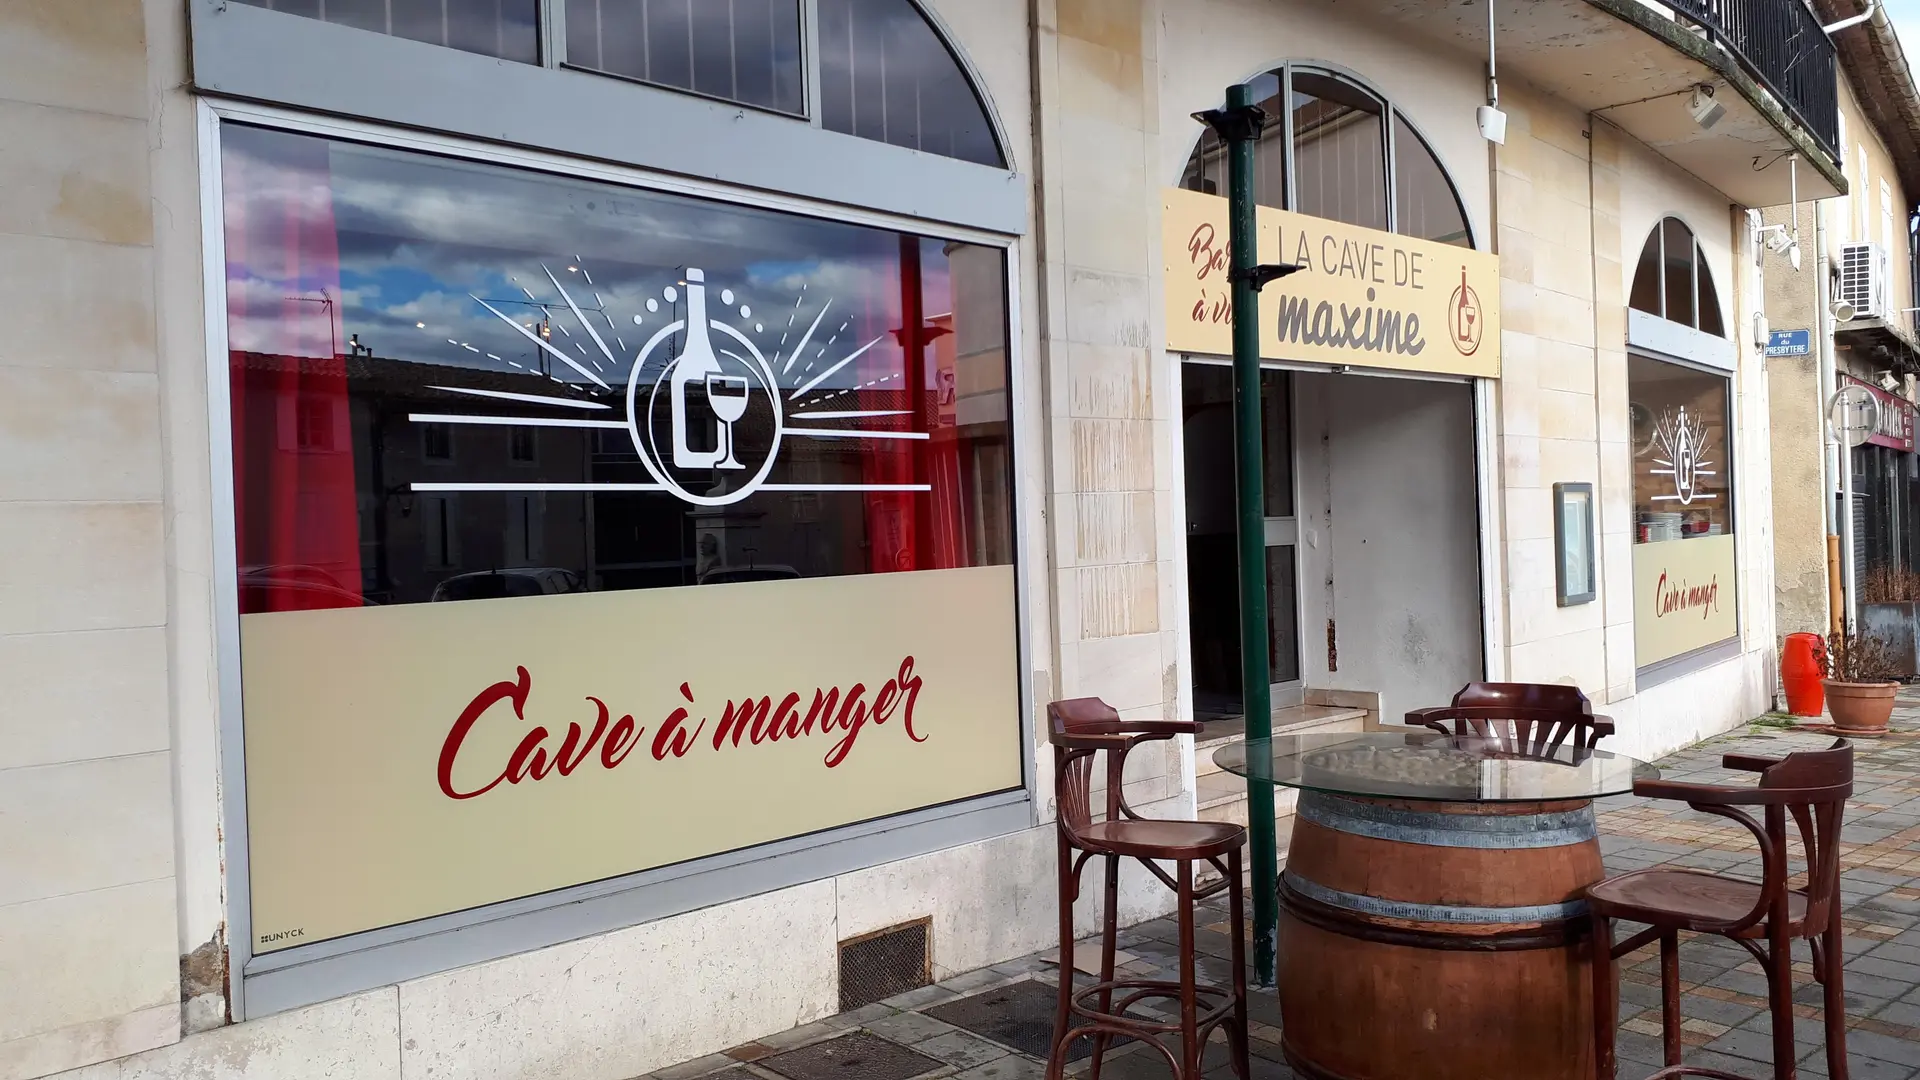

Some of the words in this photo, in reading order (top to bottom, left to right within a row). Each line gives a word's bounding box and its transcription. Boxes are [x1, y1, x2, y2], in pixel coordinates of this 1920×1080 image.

[1278, 225, 1313, 272] LA
[1321, 235, 1385, 283] CAVE
[1394, 248, 1424, 290] DE
[1192, 288, 1210, 322] à
[1277, 287, 1426, 356] maxime
[1656, 567, 1680, 618] Cave
[1688, 573, 1719, 620] manger
[437, 665, 645, 800] Cave
[651, 681, 706, 761] à
[712, 655, 929, 768] manger
[269, 927, 305, 942] UNYCK
